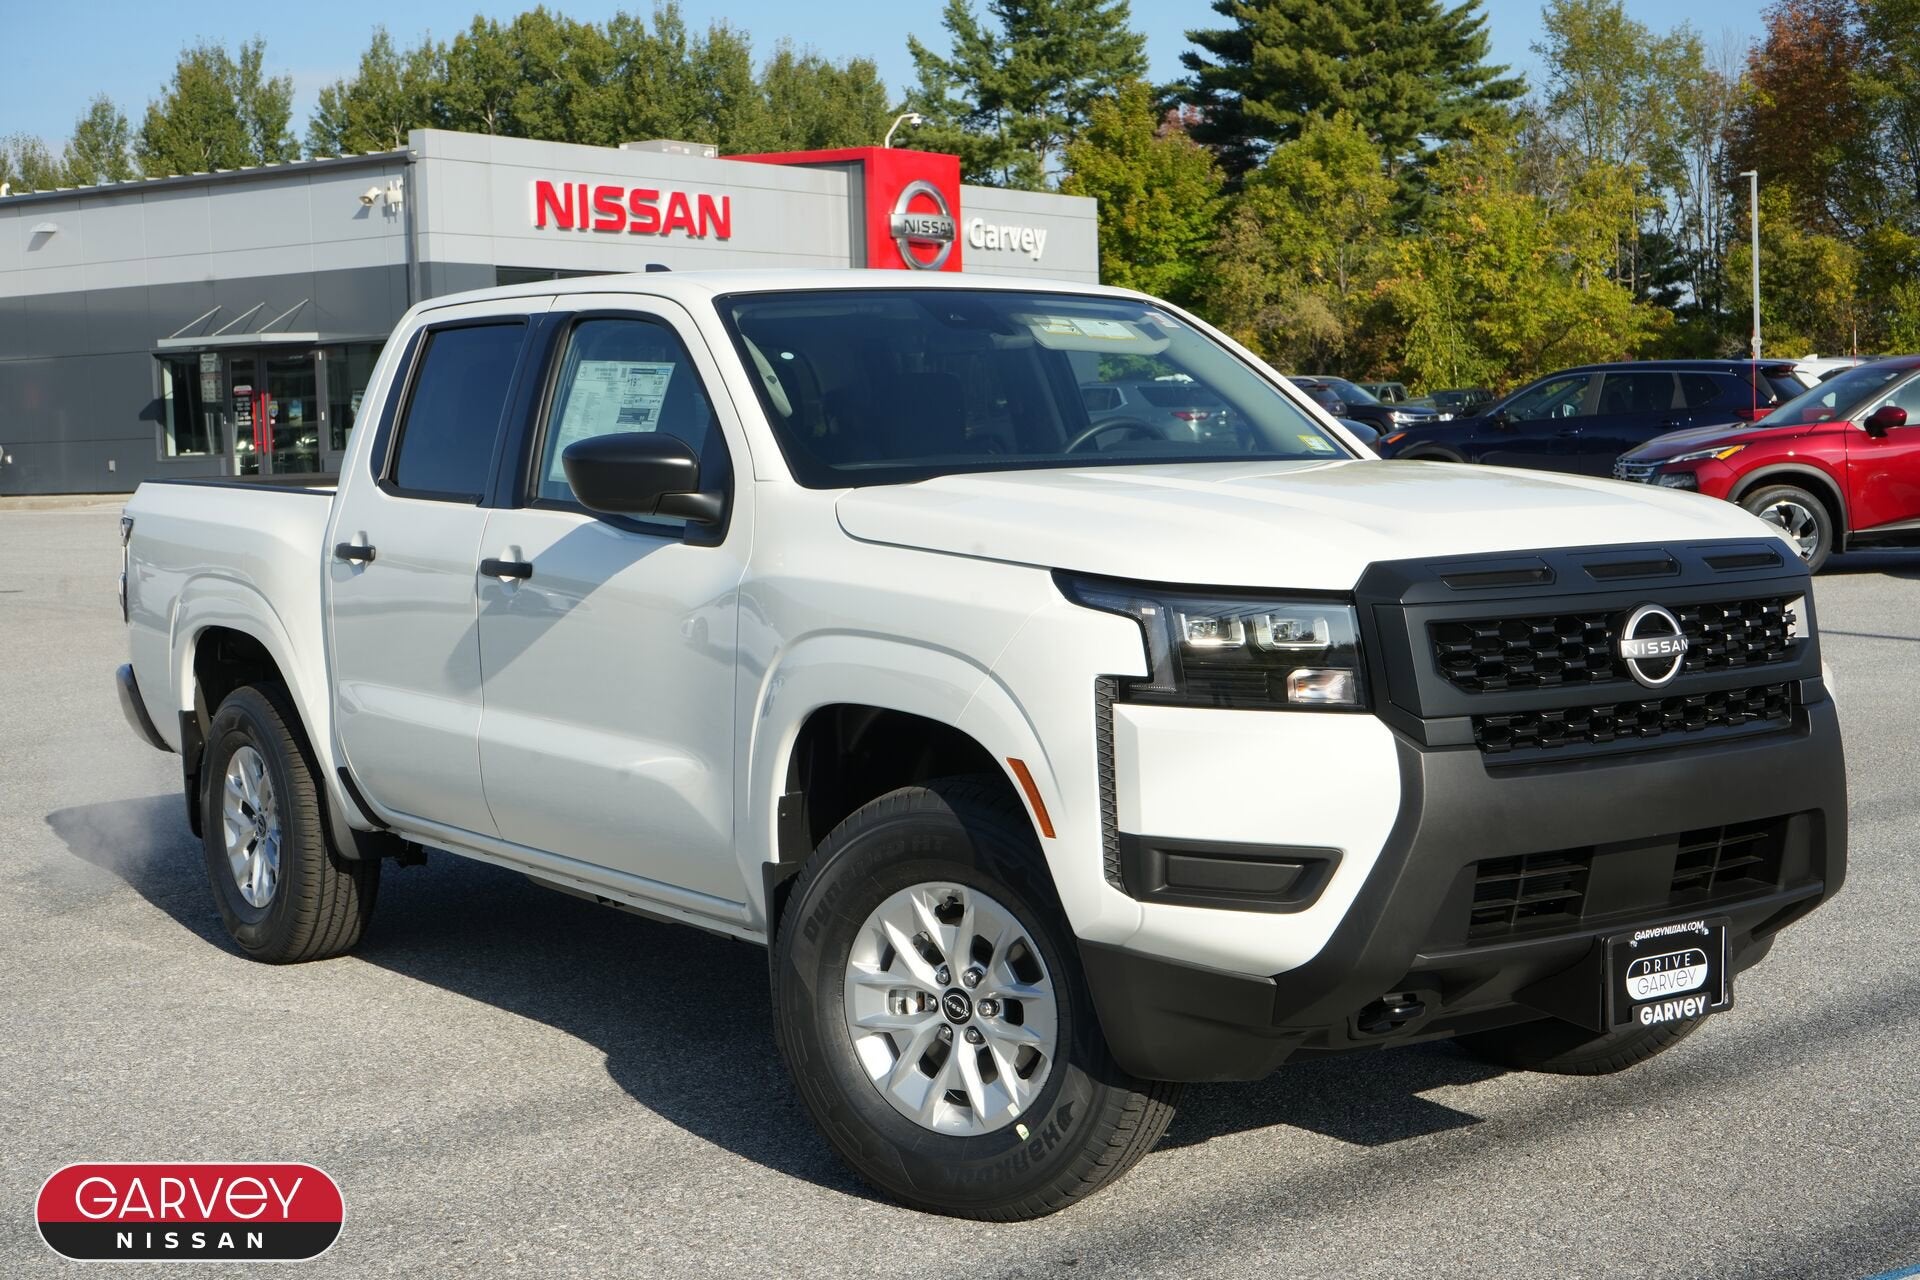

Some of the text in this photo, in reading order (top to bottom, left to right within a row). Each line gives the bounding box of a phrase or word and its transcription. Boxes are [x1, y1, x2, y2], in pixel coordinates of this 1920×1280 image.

[532, 180, 731, 239] NISSAN
[903, 219, 954, 237] NISSAN
[968, 217, 1047, 259] Garvey
[1624, 638, 1688, 656] NISSAN
[1643, 953, 1691, 974] DRIVE
